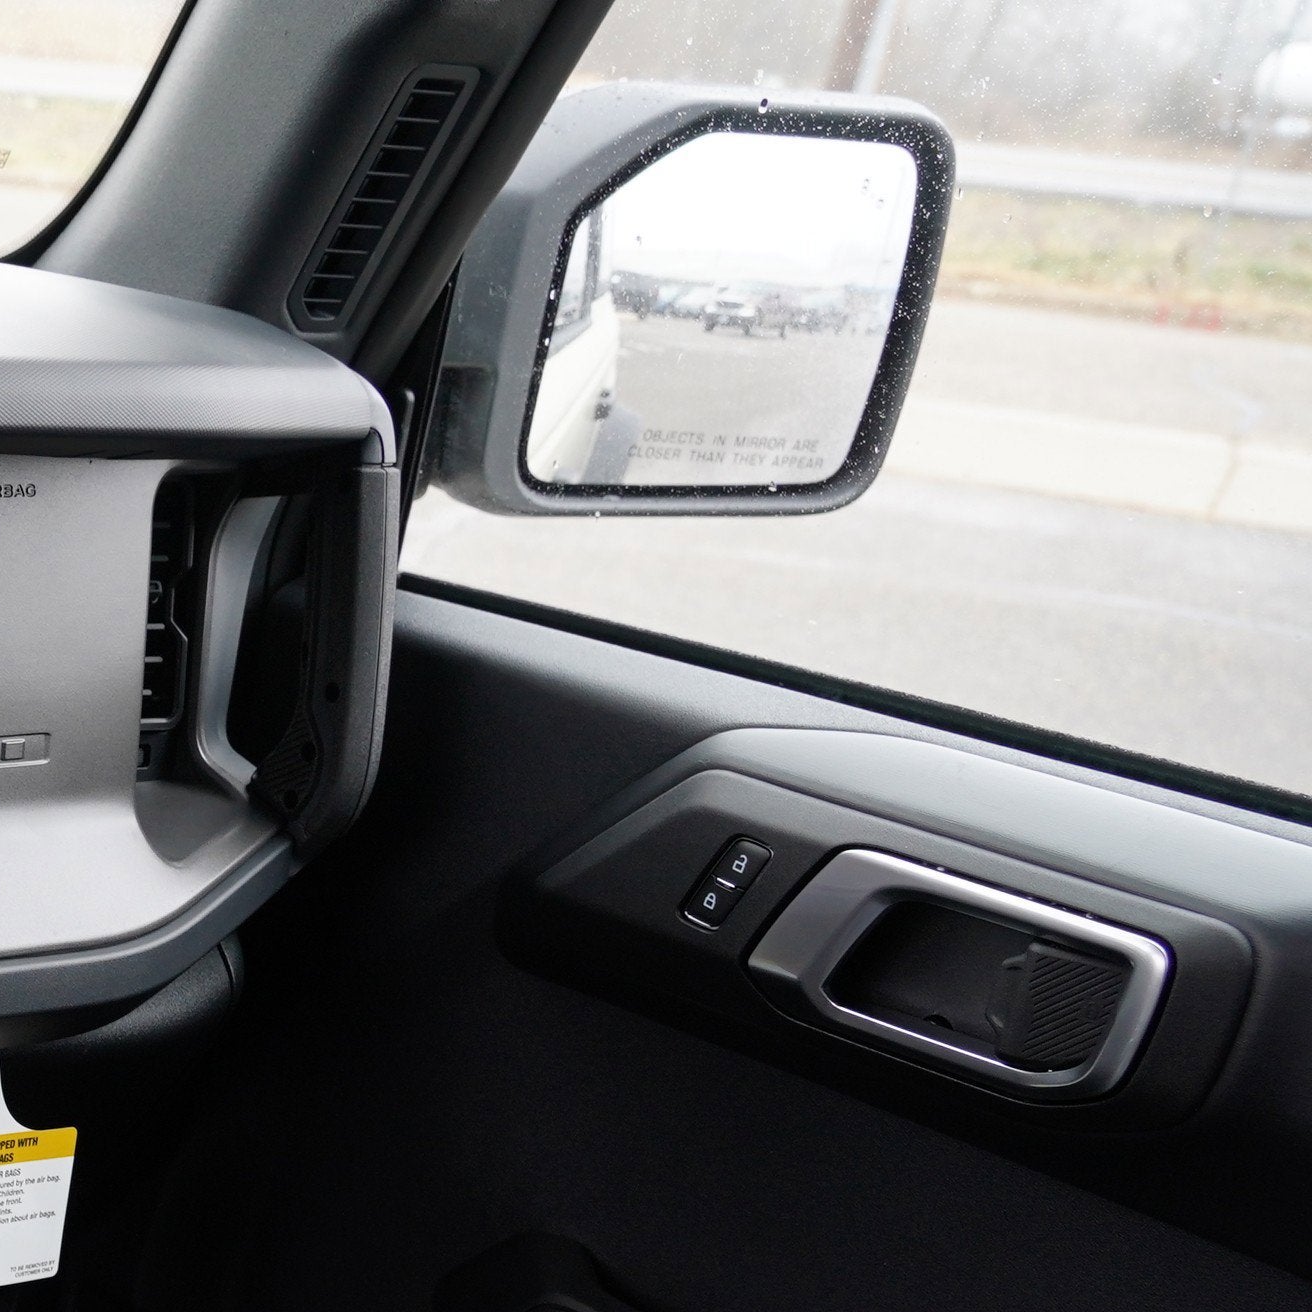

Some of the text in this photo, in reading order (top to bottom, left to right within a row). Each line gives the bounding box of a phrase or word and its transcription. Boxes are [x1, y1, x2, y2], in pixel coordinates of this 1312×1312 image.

[642, 429, 820, 453] OBJECTS IN MIRROR ARE
[626, 444, 824, 469] CLOSER THAN THEY APPEAR
[17, 1136, 39, 1148] WITH
[4, 1168, 21, 1178] BAGS
[15, 1179, 24, 1187] by
[25, 1177, 35, 1185] the
[36, 1175, 45, 1183] air
[10, 1214, 28, 1223] about
